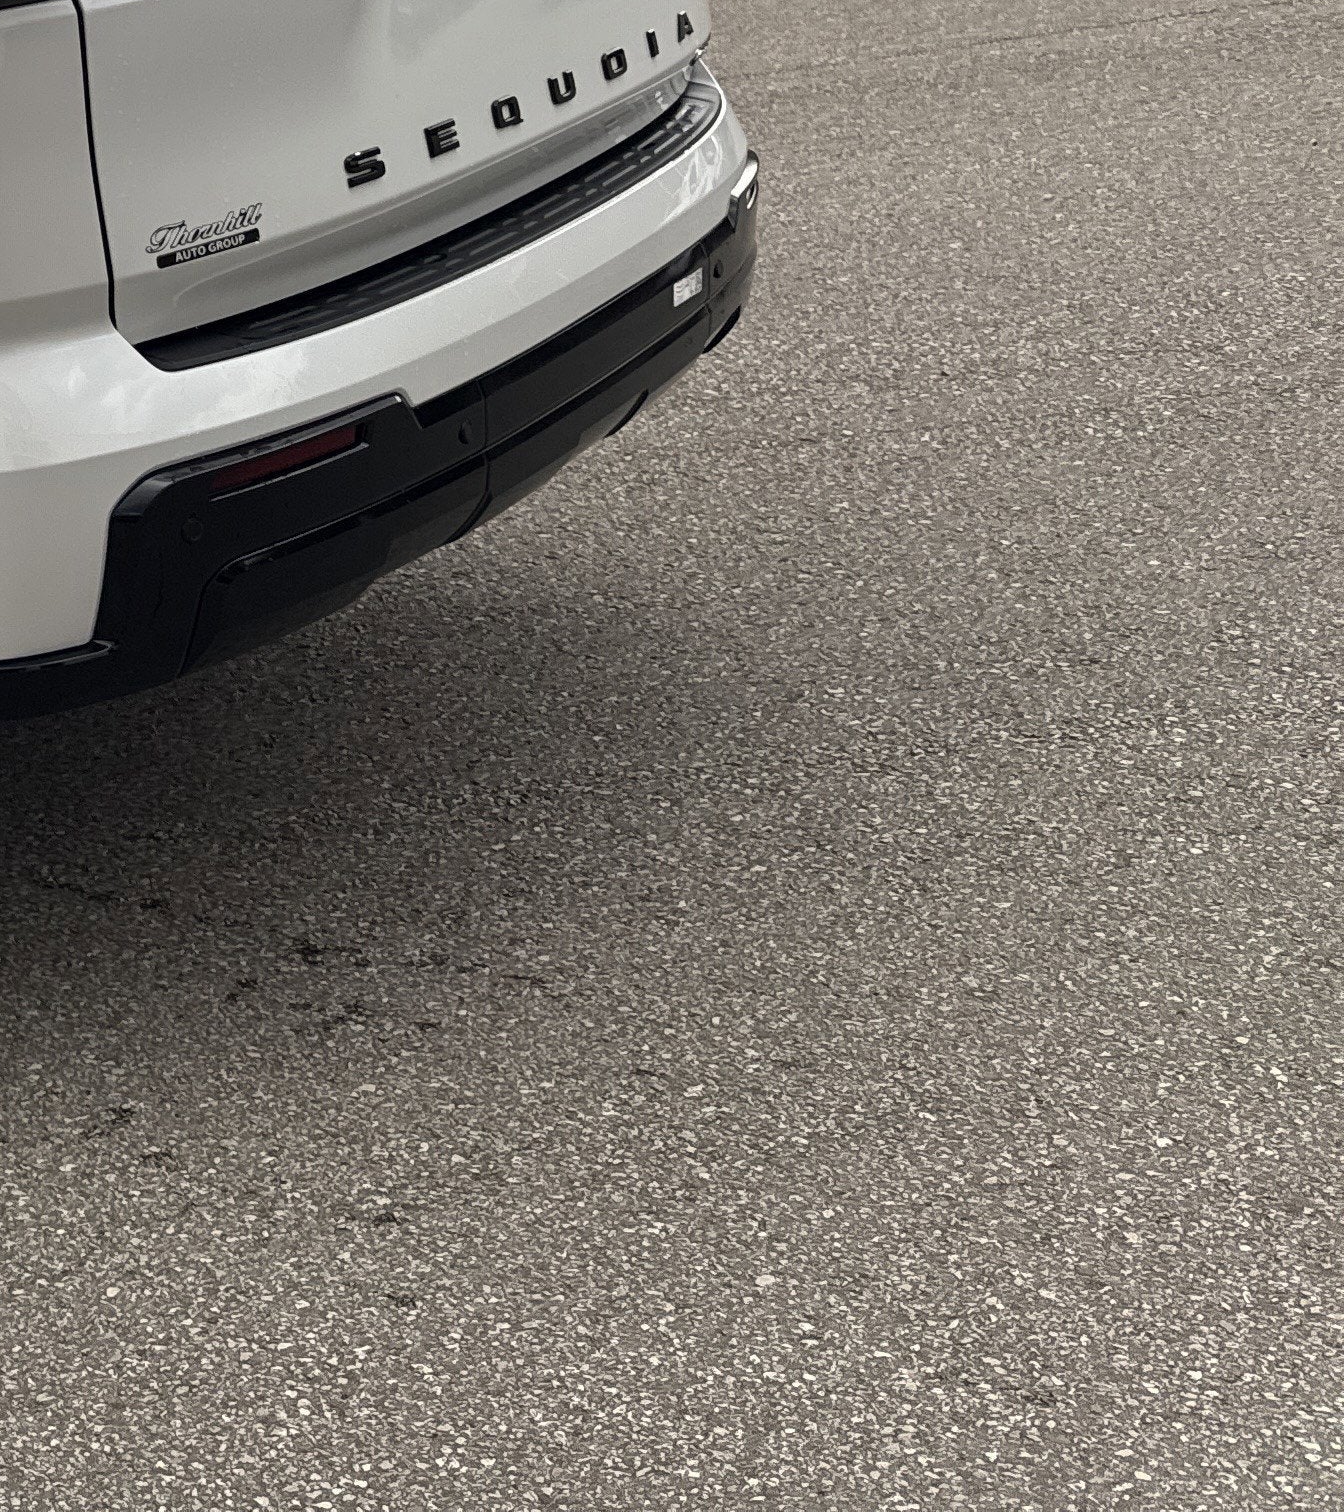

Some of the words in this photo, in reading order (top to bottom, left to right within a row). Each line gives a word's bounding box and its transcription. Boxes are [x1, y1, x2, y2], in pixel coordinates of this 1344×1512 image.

[343, 11, 694, 188] SEQUOIA
[145, 202, 263, 254] Thornhill
[175, 245, 207, 263] AUTO
[208, 234, 245, 253] GROUP
